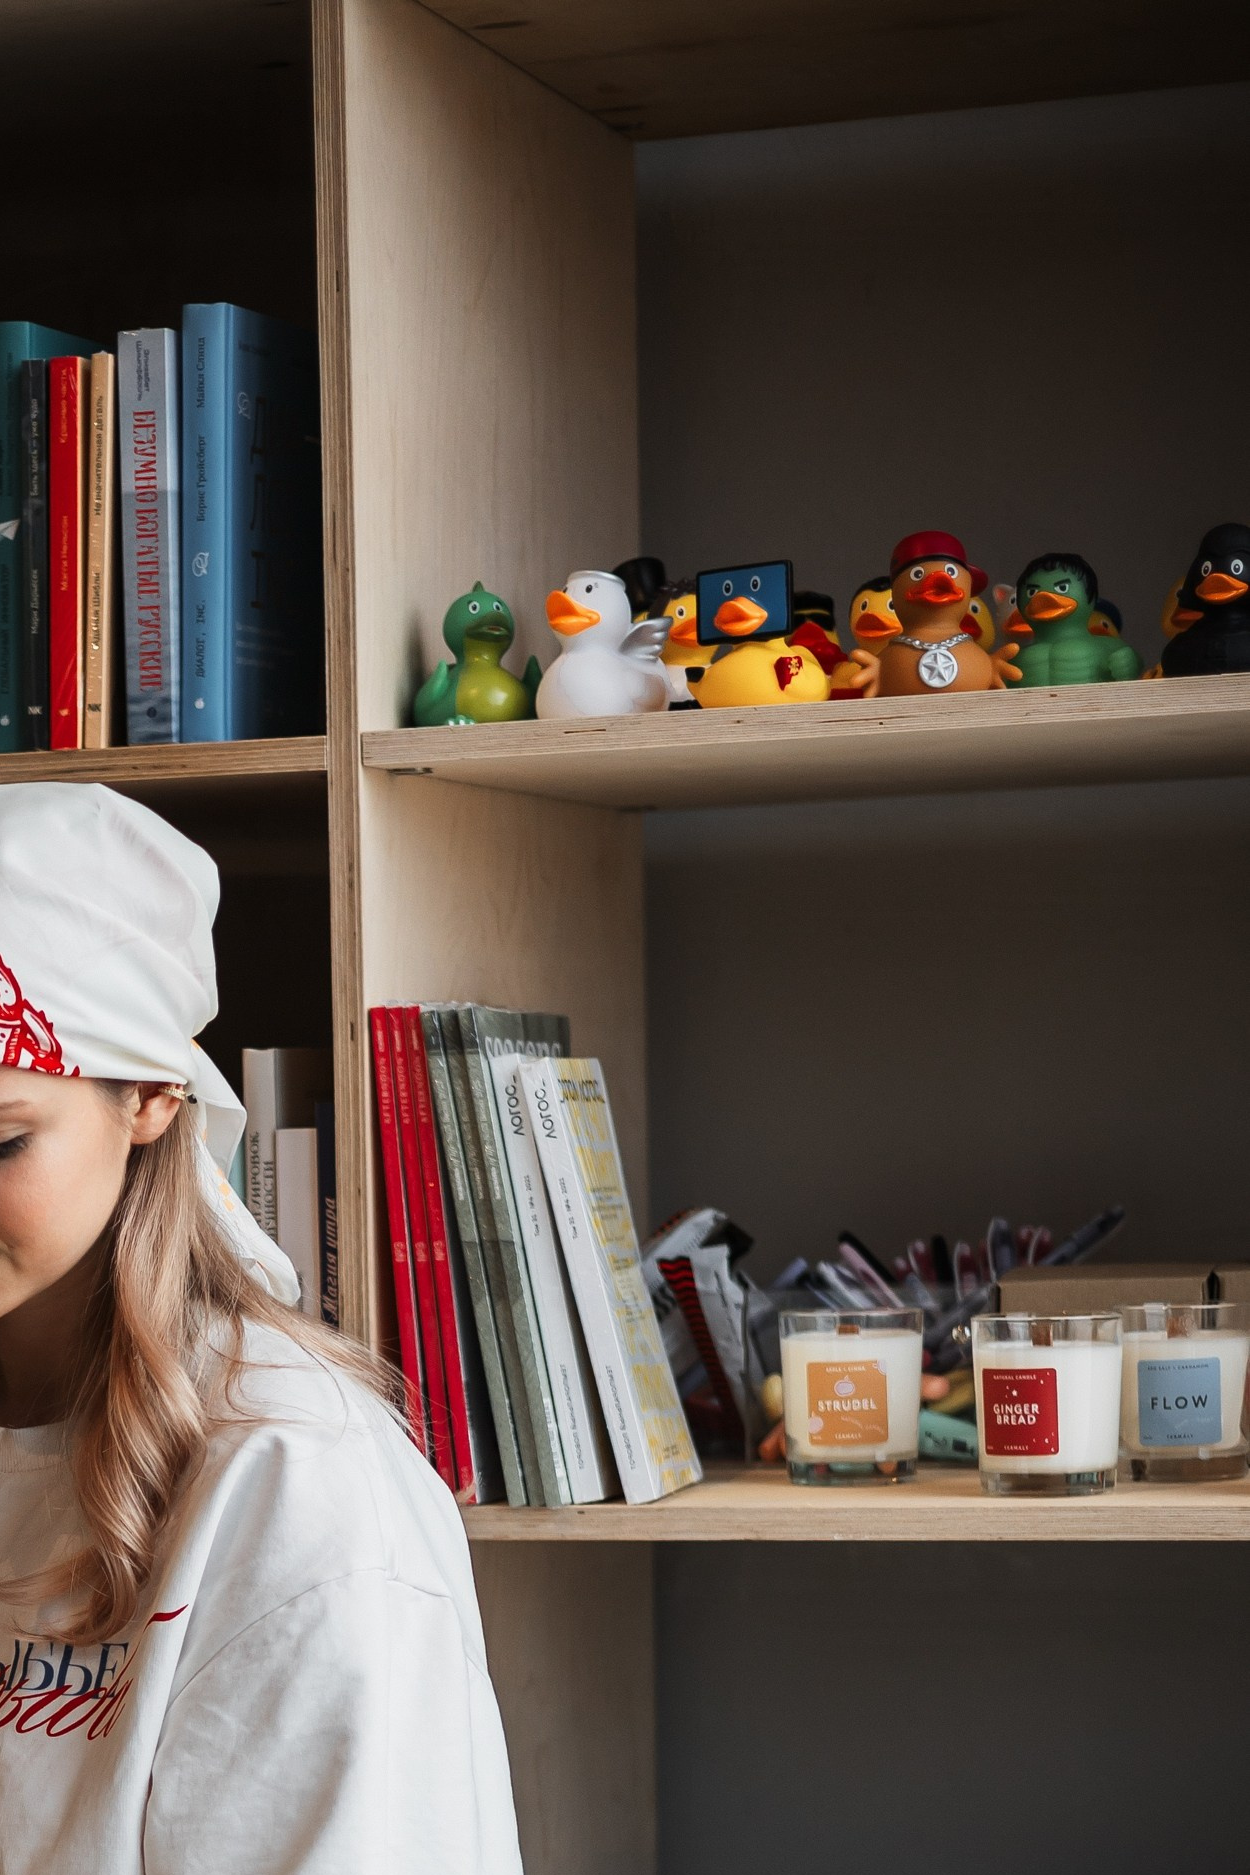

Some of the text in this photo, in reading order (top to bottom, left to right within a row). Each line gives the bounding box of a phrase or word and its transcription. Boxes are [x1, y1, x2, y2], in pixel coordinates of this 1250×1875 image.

[195, 373, 205, 409] Майкл
[196, 492, 205, 522] Борис
[133, 410, 163, 692] БЕЗУМНО БОГАТЫЕ РУССКИЕ
[323, 1196, 338, 1321] Магия утра
[817, 1398, 878, 1413] STRUDEL
[993, 1403, 1040, 1415] GINGER
[1150, 1395, 1208, 1410] FLOW
[996, 1414, 1037, 1426] BREAD
